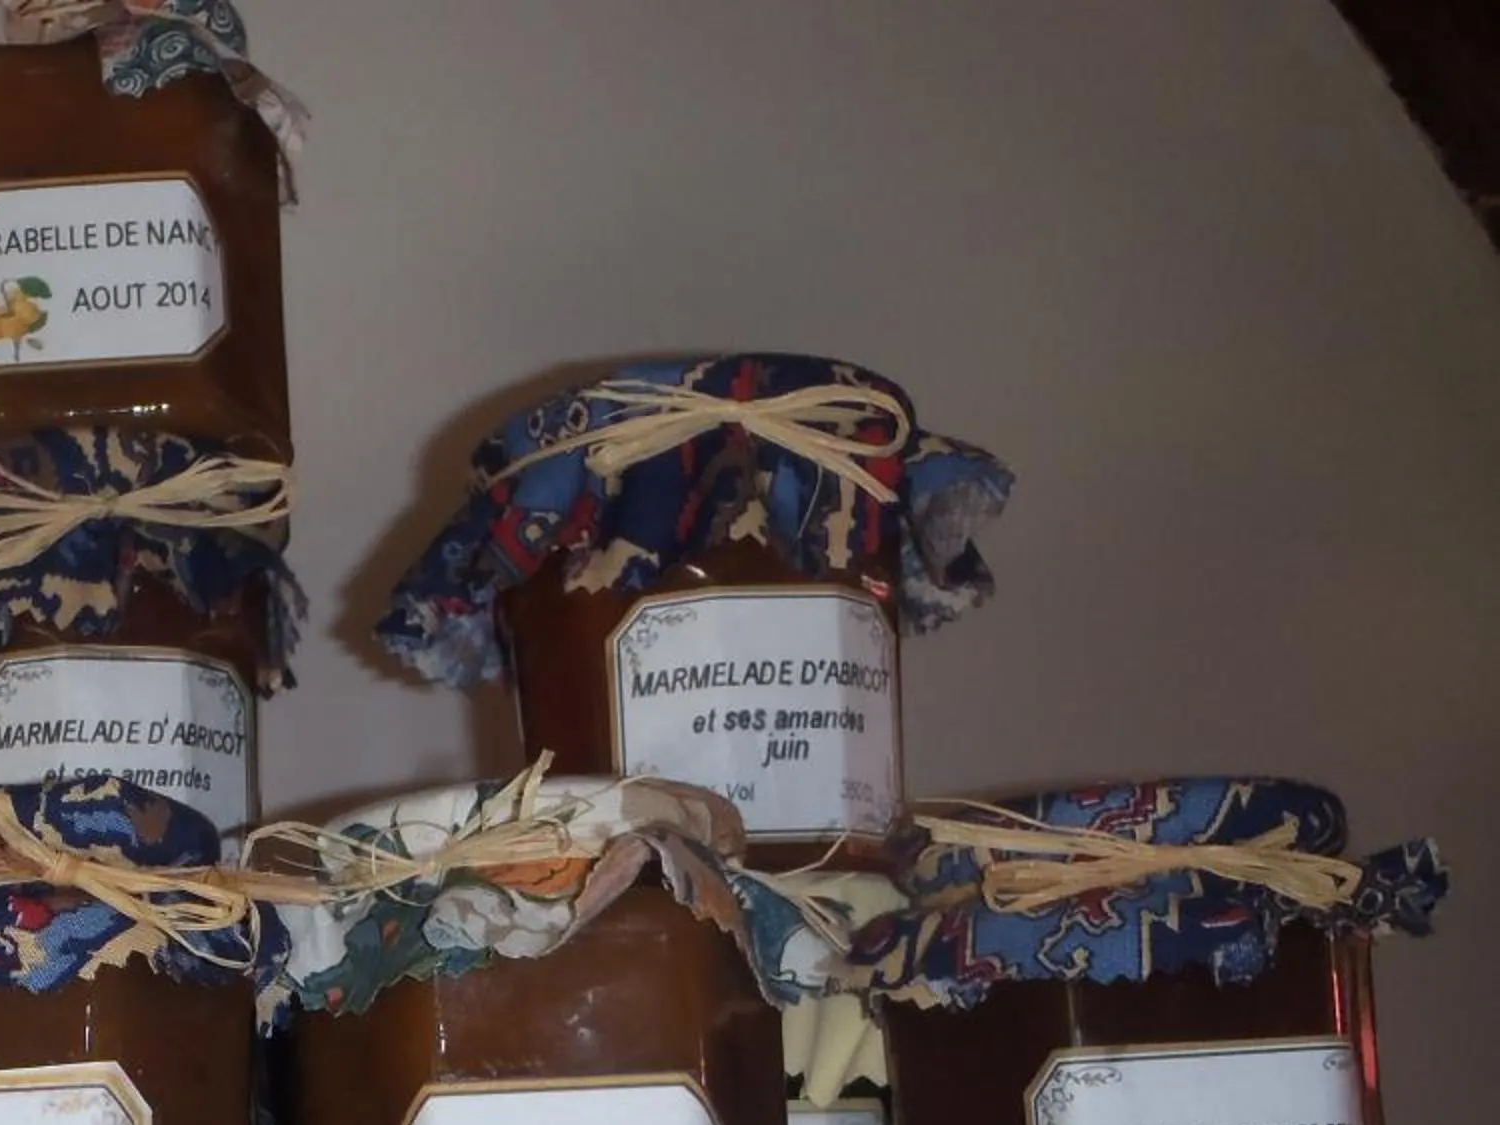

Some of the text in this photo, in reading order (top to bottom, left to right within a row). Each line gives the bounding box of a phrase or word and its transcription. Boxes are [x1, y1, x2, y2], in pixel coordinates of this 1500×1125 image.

[106, 221, 140, 248] DE
[71, 281, 211, 312] AOUT 2014
[632, 660, 792, 698] MARMELADE
[693, 709, 716, 733] et
[723, 709, 766, 731] ses
[762, 733, 809, 767] juin
[122, 766, 212, 791] amandes
